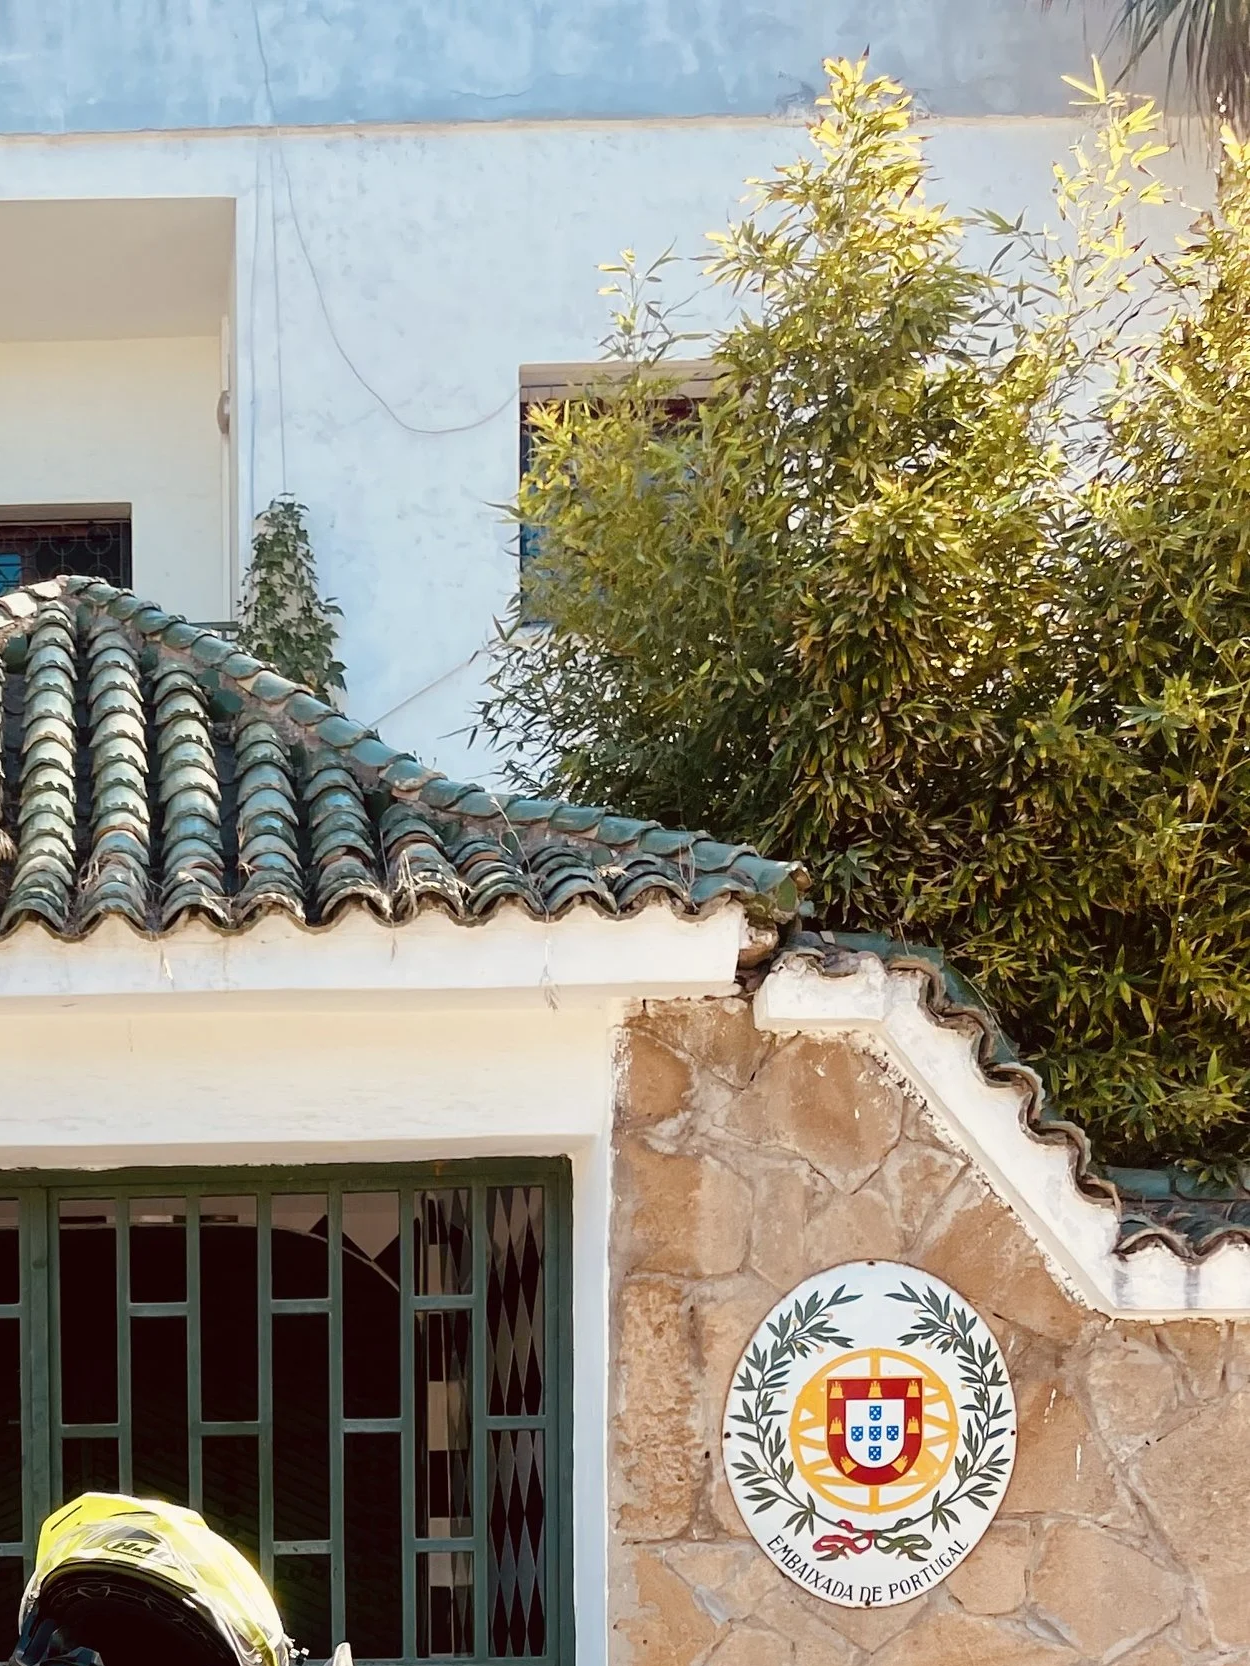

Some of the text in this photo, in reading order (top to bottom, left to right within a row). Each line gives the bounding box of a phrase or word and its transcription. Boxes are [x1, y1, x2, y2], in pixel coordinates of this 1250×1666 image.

[766, 1534, 969, 1603] EMBAIXADA DE PORTUGAL
